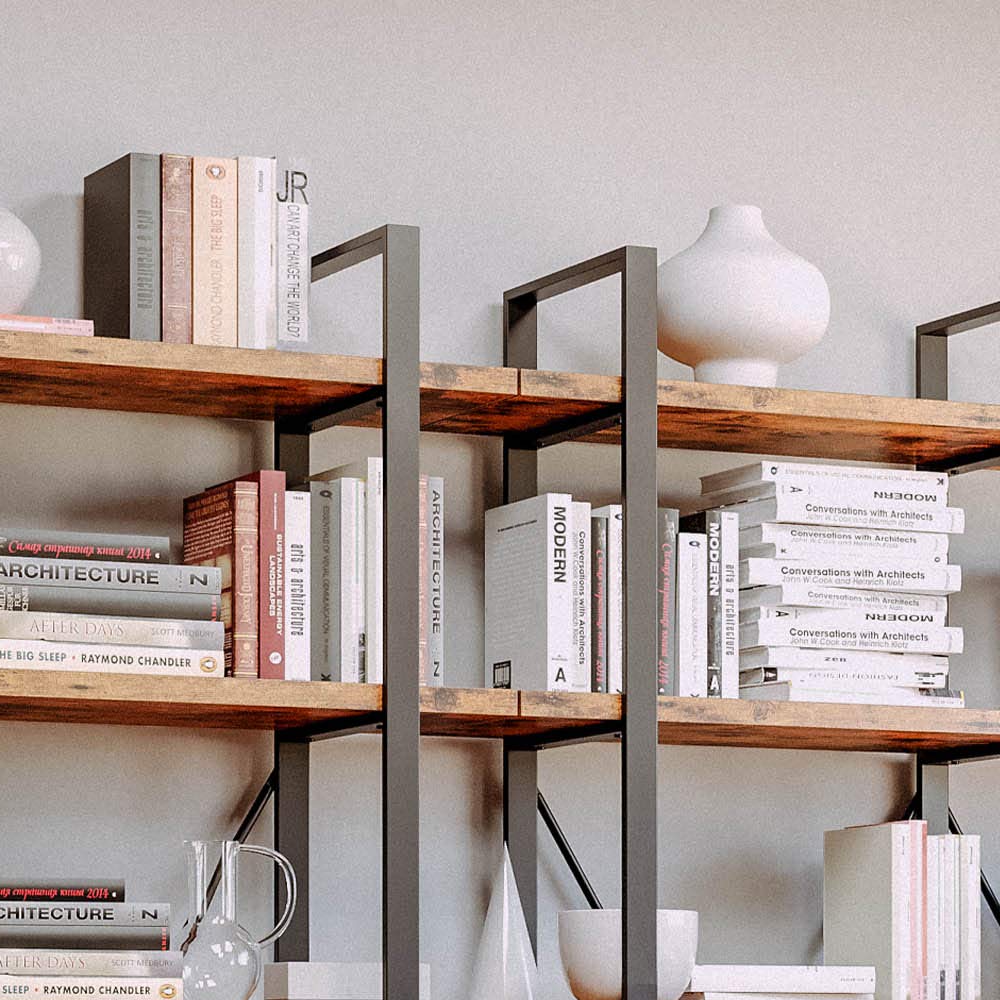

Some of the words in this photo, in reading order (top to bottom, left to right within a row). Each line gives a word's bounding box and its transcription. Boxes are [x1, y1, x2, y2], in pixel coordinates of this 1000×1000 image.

[275, 170, 309, 205] JR
[287, 204, 300, 224] CAN
[287, 224, 300, 242] ART
[287, 243, 300, 279] CHANGE
[287, 280, 300, 298] THE
[287, 299, 300, 337] WORLD?
[873, 491, 937, 502] MODERN
[805, 503, 868, 517] Conversations
[869, 507, 889, 518] with
[890, 508, 933, 521] Architects
[126, 546, 151, 560] 2014
[553, 506, 567, 583] MODERN
[432, 489, 441, 635] ARCHITECTURE
[708, 522, 721, 596] MODERN
[780, 566, 851, 577] Conversations
[853, 568, 874, 577] with
[876, 569, 925, 580] Architects
[865, 613, 934, 623] MODERN
[789, 628, 857, 639] Conversations
[859, 629, 879, 640] with
[882, 630, 929, 641] Architects
[16, 650, 35, 662] BIG
[38, 651, 67, 662] SLEEP
[81, 653, 134, 665] RAYMOND
[138, 655, 192, 668] CHANDLER
[86, 888, 110, 899] 2014
[47, 957, 86, 969] DAYS
[2, 985, 30, 994] SLEEP
[43, 986, 95, 995] RAYMOND
[98, 986, 151, 995] CHANDLER
